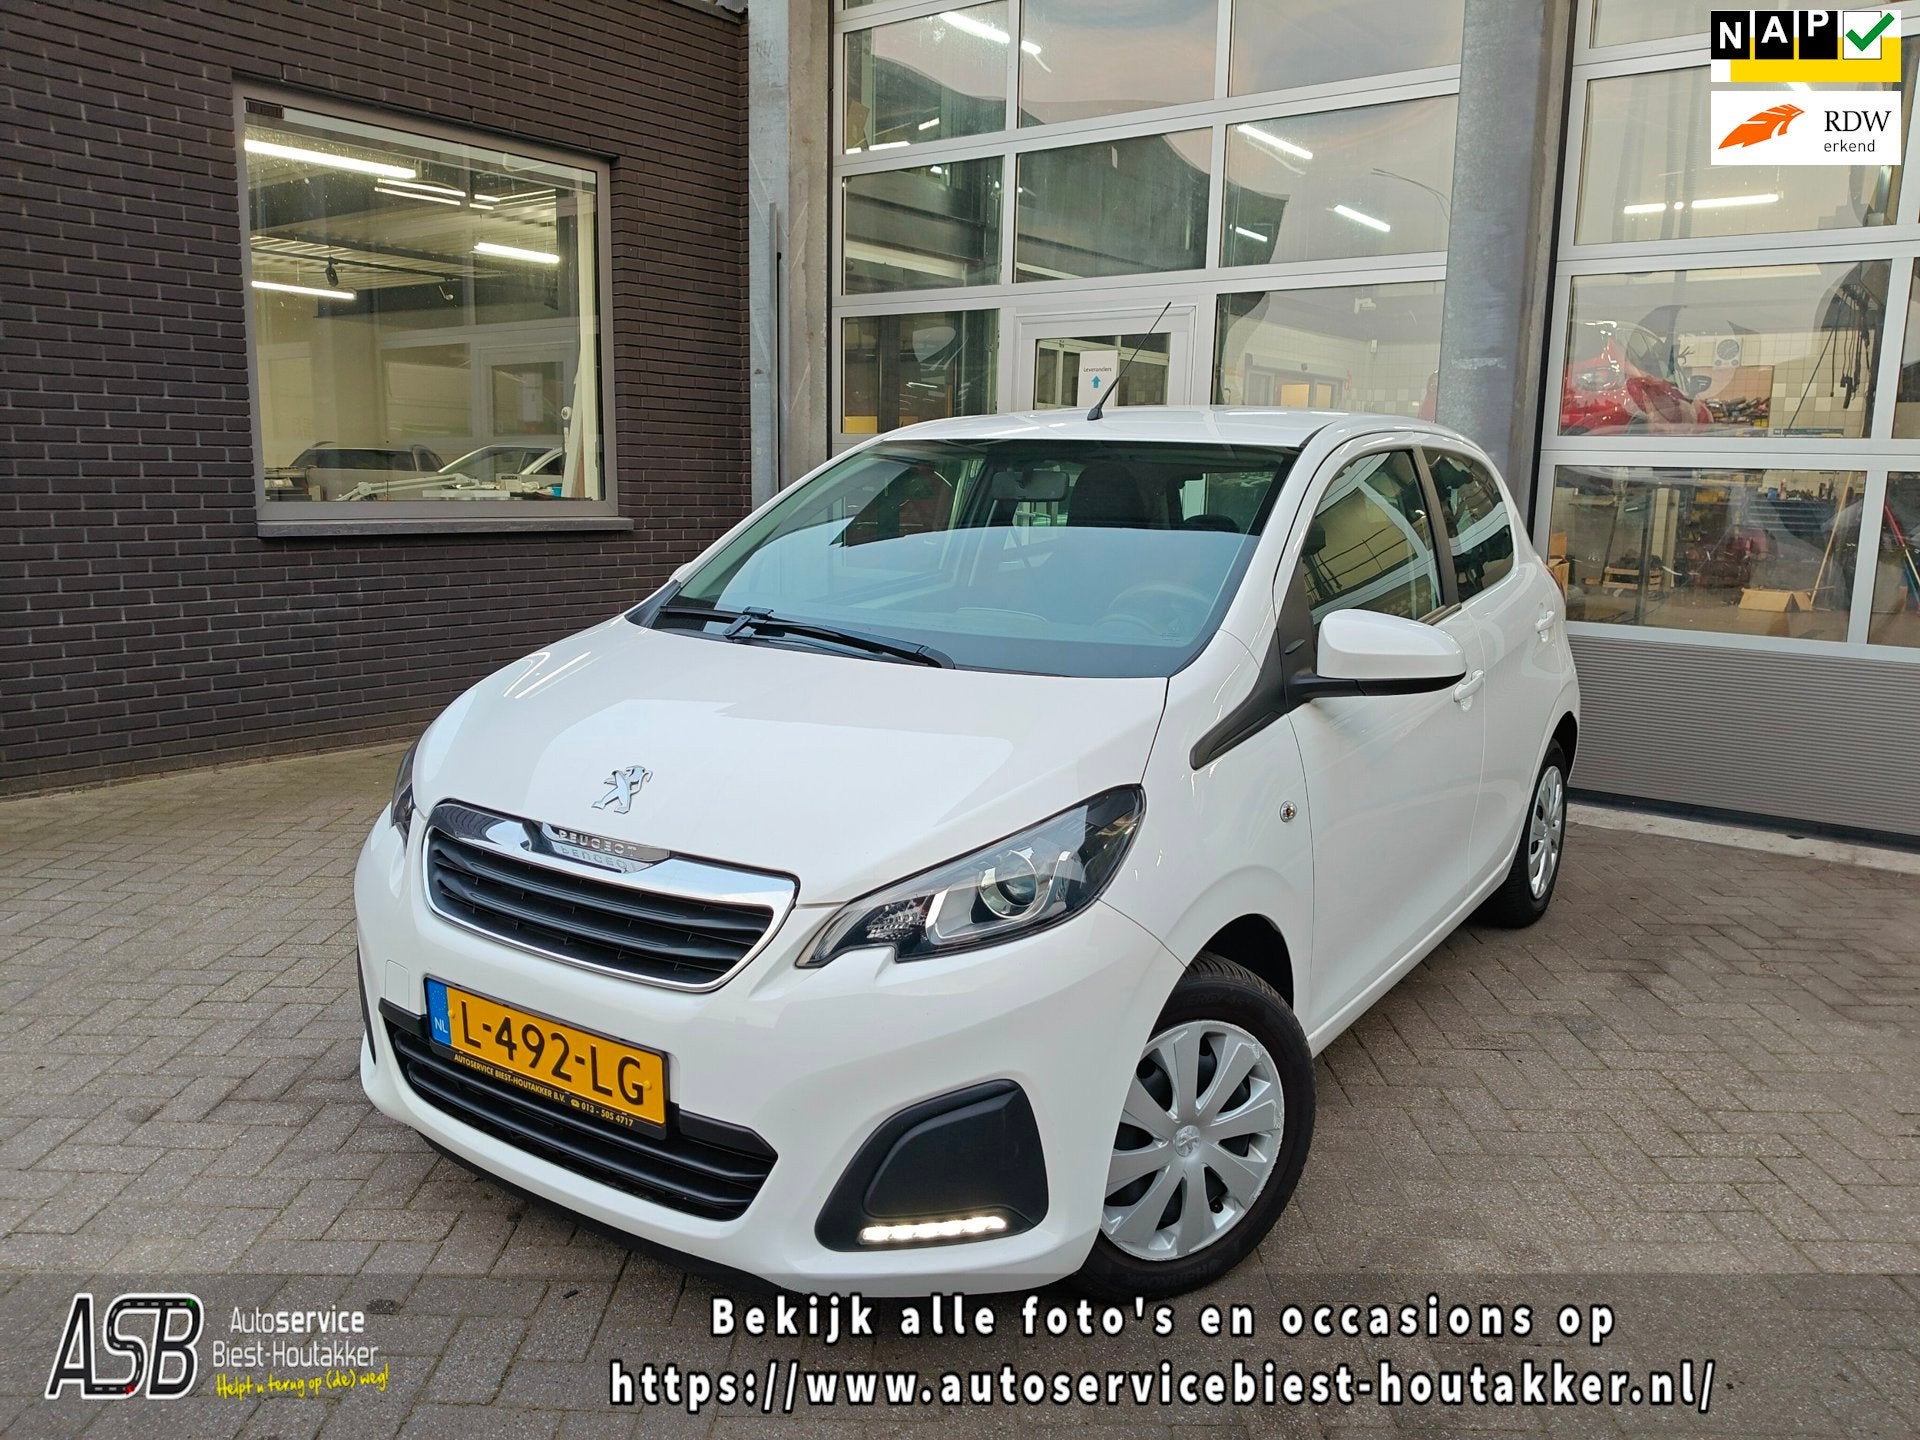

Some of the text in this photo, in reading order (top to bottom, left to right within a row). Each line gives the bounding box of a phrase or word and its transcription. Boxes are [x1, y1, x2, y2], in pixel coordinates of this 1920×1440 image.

[558, 829, 637, 858] PEUGEOT
[434, 1017, 449, 1034] NL
[460, 1000, 645, 1107] L-492-LG
[454, 1053, 494, 1076] AUTOSERVICE
[494, 1069, 553, 1098] BIEST-HOUTAKKER
[581, 1102, 596, 1115] 013
[601, 1108, 614, 1121] 505
[615, 1112, 634, 1127] 4717
